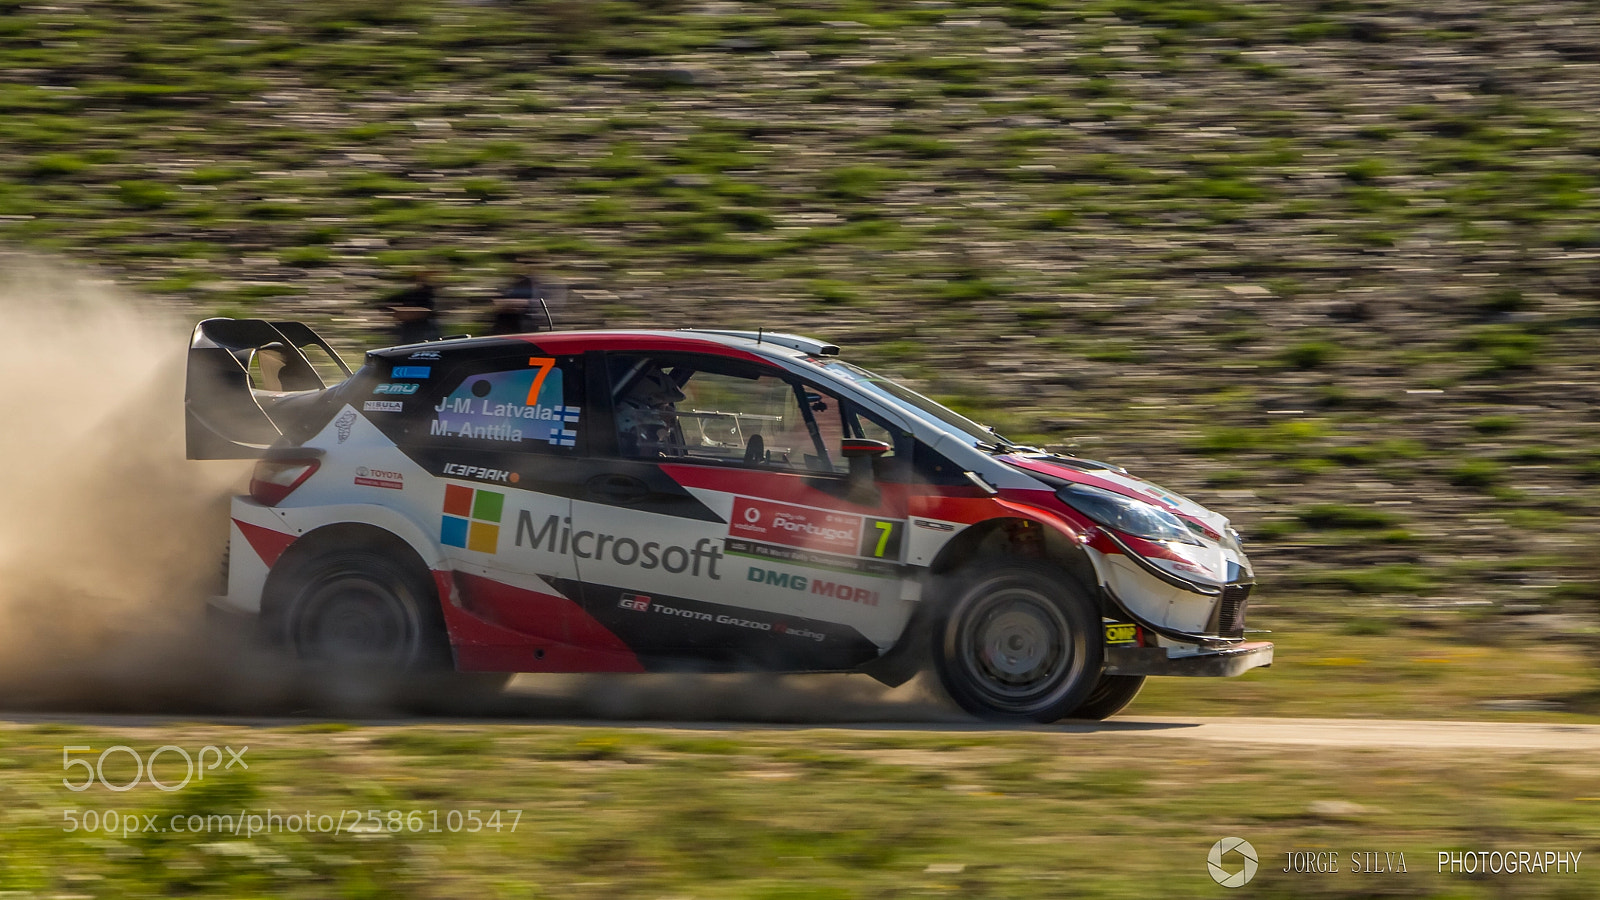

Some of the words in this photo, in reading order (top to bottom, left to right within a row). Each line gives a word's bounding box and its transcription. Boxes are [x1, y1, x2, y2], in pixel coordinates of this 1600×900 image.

[526, 357, 556, 406] 7
[434, 397, 475, 415] J-M.
[482, 400, 553, 421] Latvala
[430, 419, 452, 437] M.
[458, 420, 523, 443] Anttila
[370, 469, 404, 480] TOYOTA
[733, 523, 767, 533] vodafone
[772, 517, 856, 540] Portugal
[874, 521, 893, 557] 7
[515, 509, 724, 581] Microsoft
[747, 566, 808, 591] DMG
[811, 579, 881, 607] MORI
[620, 599, 648, 611] GR
[653, 604, 713, 622] TOYOTA
[773, 621, 825, 642] Racing
[1105, 628, 1137, 641] OMP
